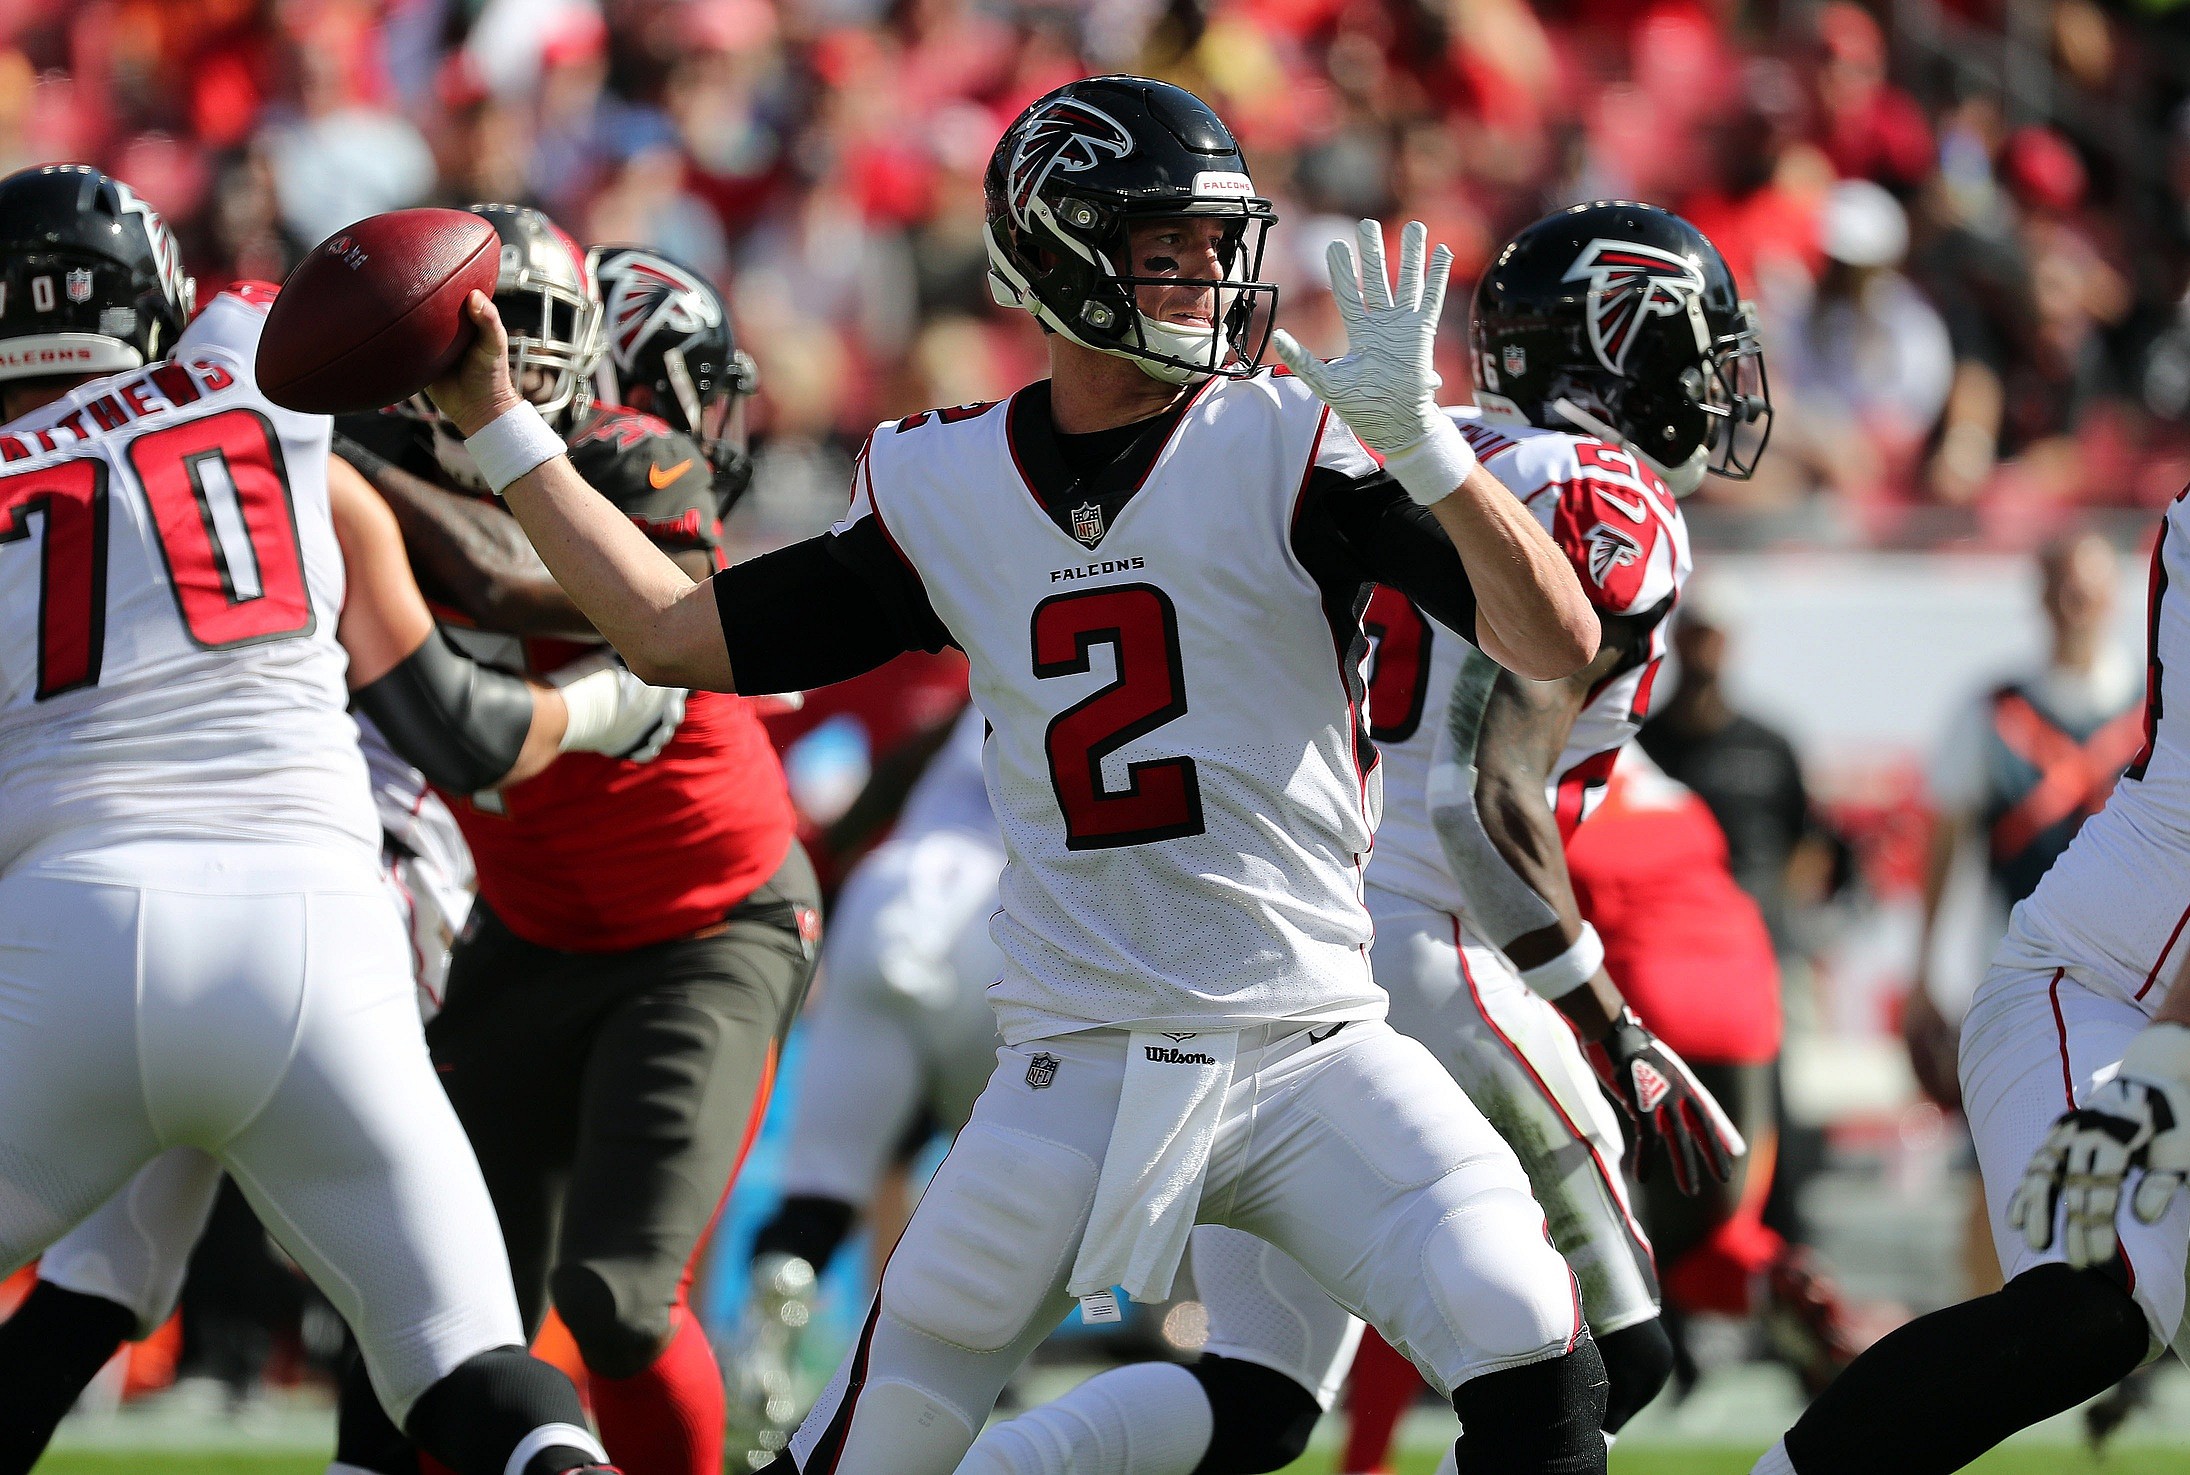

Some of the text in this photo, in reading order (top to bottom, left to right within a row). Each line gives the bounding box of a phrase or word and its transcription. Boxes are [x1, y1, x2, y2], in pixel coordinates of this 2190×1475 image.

[1203, 181, 1250, 191] FALCONS
[1077, 521, 1100, 537] NFL
[0, 409, 318, 700] 70
[1049, 556, 1145, 583] FALCONS
[1030, 582, 1206, 851] 2
[1144, 1046, 1208, 1065] Wilson
[1027, 1065, 1052, 1084] NFL
